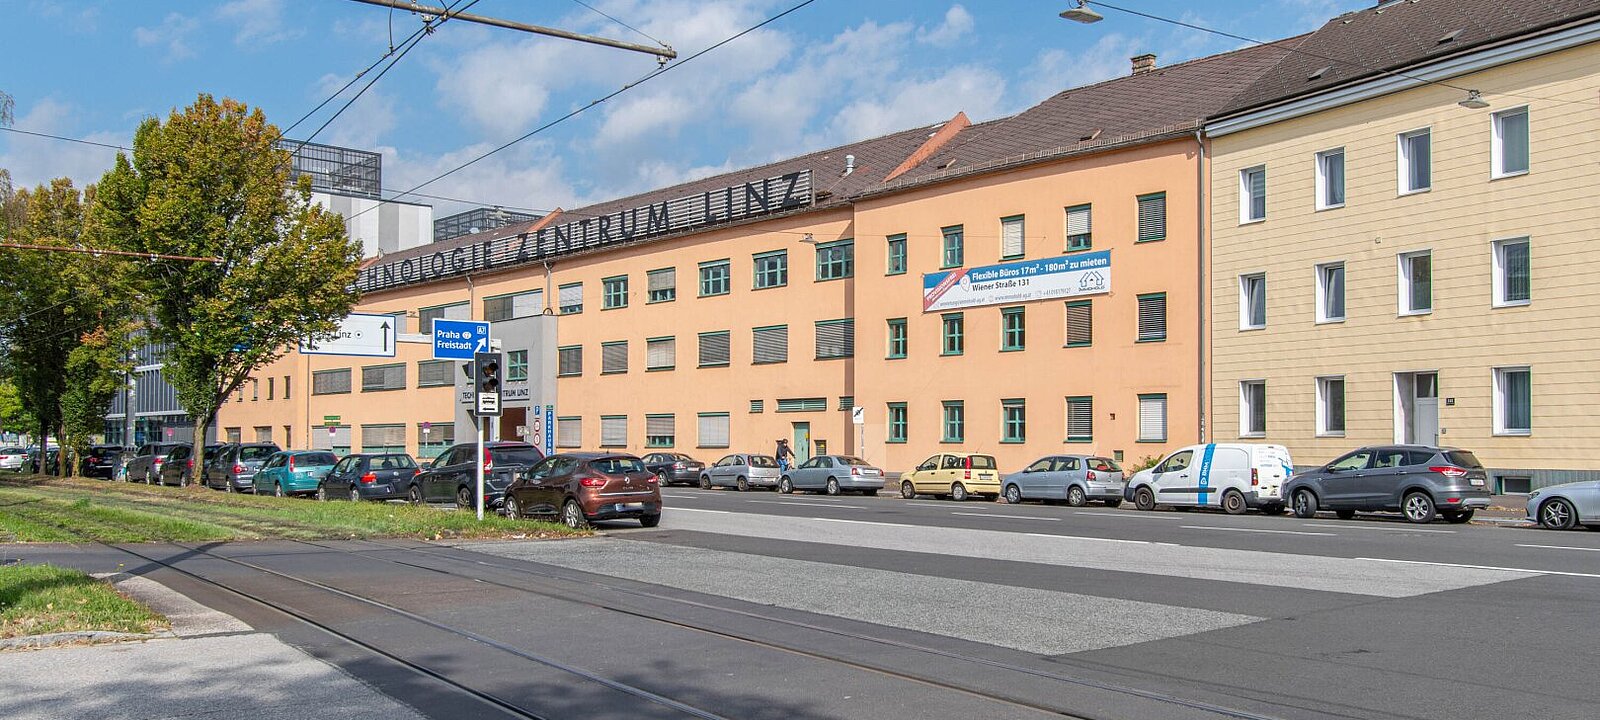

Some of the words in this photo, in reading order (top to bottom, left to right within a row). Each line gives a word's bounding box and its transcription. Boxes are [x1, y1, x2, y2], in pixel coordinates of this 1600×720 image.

[516, 200, 671, 262] ZENTRUM
[704, 171, 801, 223] LINZ
[972, 270, 999, 281] Flexible
[999, 268, 1019, 278] Büros
[1070, 261, 1079, 269] zu
[1080, 258, 1107, 268] mieten
[972, 283, 994, 292] Wiener
[995, 280, 1016, 289] Straße
[1018, 278, 1029, 287] 131
[437, 330, 460, 339] Praha
[437, 340, 472, 350] Freistadt
[517, 388, 528, 396] LINZ
